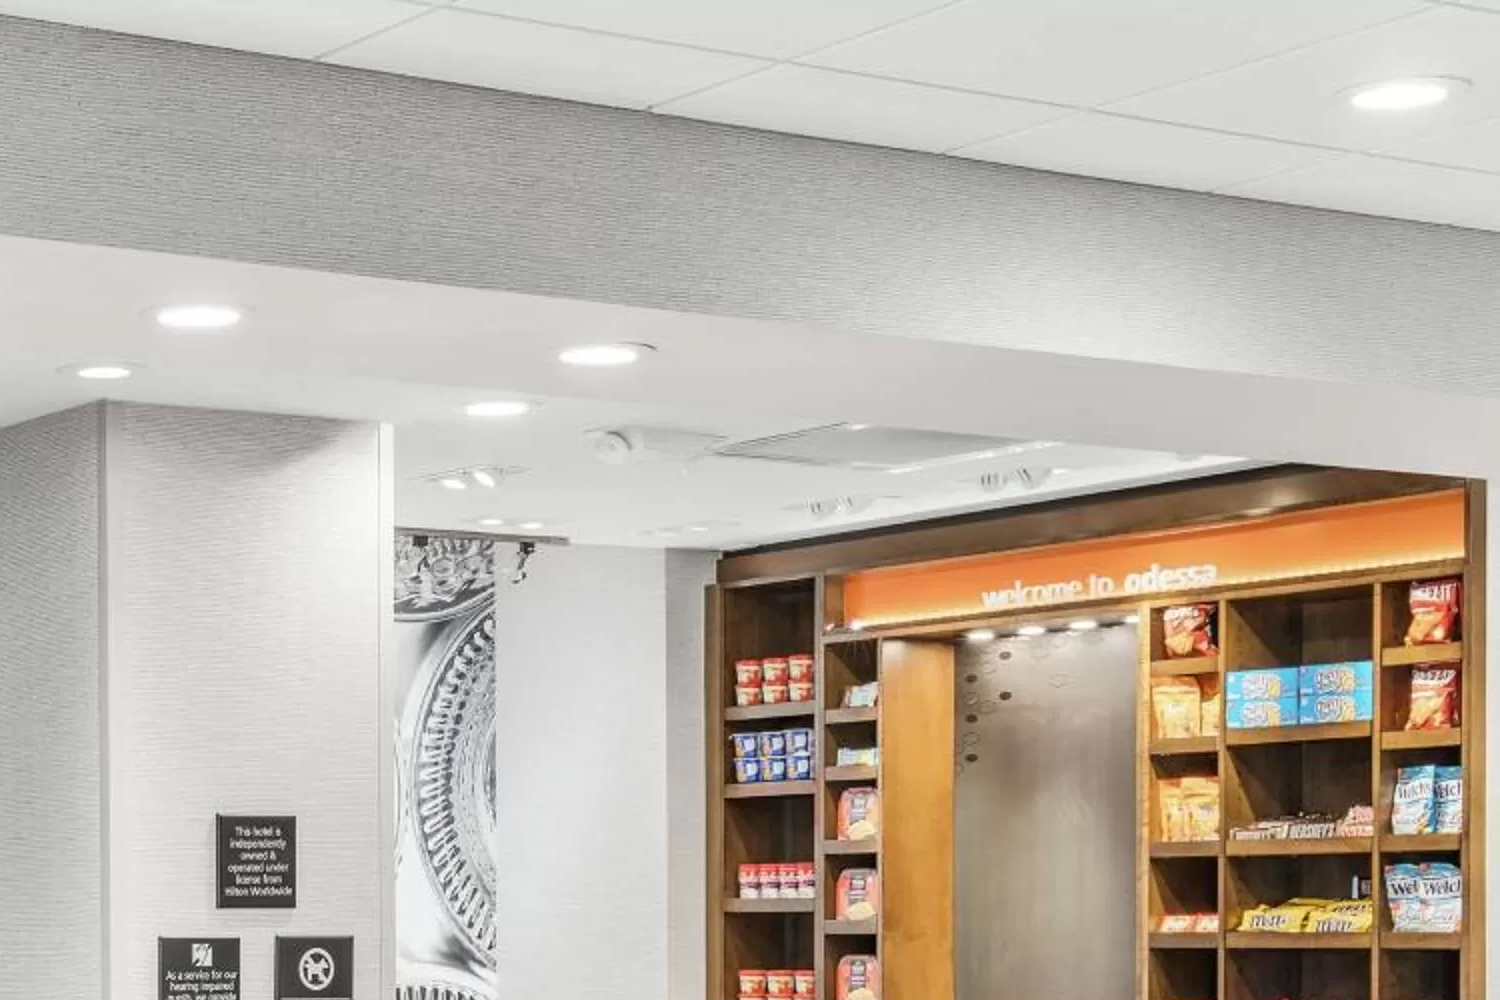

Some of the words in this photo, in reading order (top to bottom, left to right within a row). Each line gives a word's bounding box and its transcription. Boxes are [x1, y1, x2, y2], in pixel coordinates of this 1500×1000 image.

[981, 579, 1082, 609] welcome
[1086, 573, 1114, 598] to
[1123, 562, 1218, 595] odessa
[234, 825, 250, 837] This
[252, 825, 273, 837] hotel
[229, 837, 287, 851] independently
[240, 850, 268, 861] owned
[227, 862, 264, 875] operated
[265, 862, 289, 873] under
[263, 873, 282, 885] from
[249, 886, 293, 897] Worldwide
[211, 969, 223, 980] for
[223, 971, 238, 980] our
[169, 981, 199, 994] hearing
